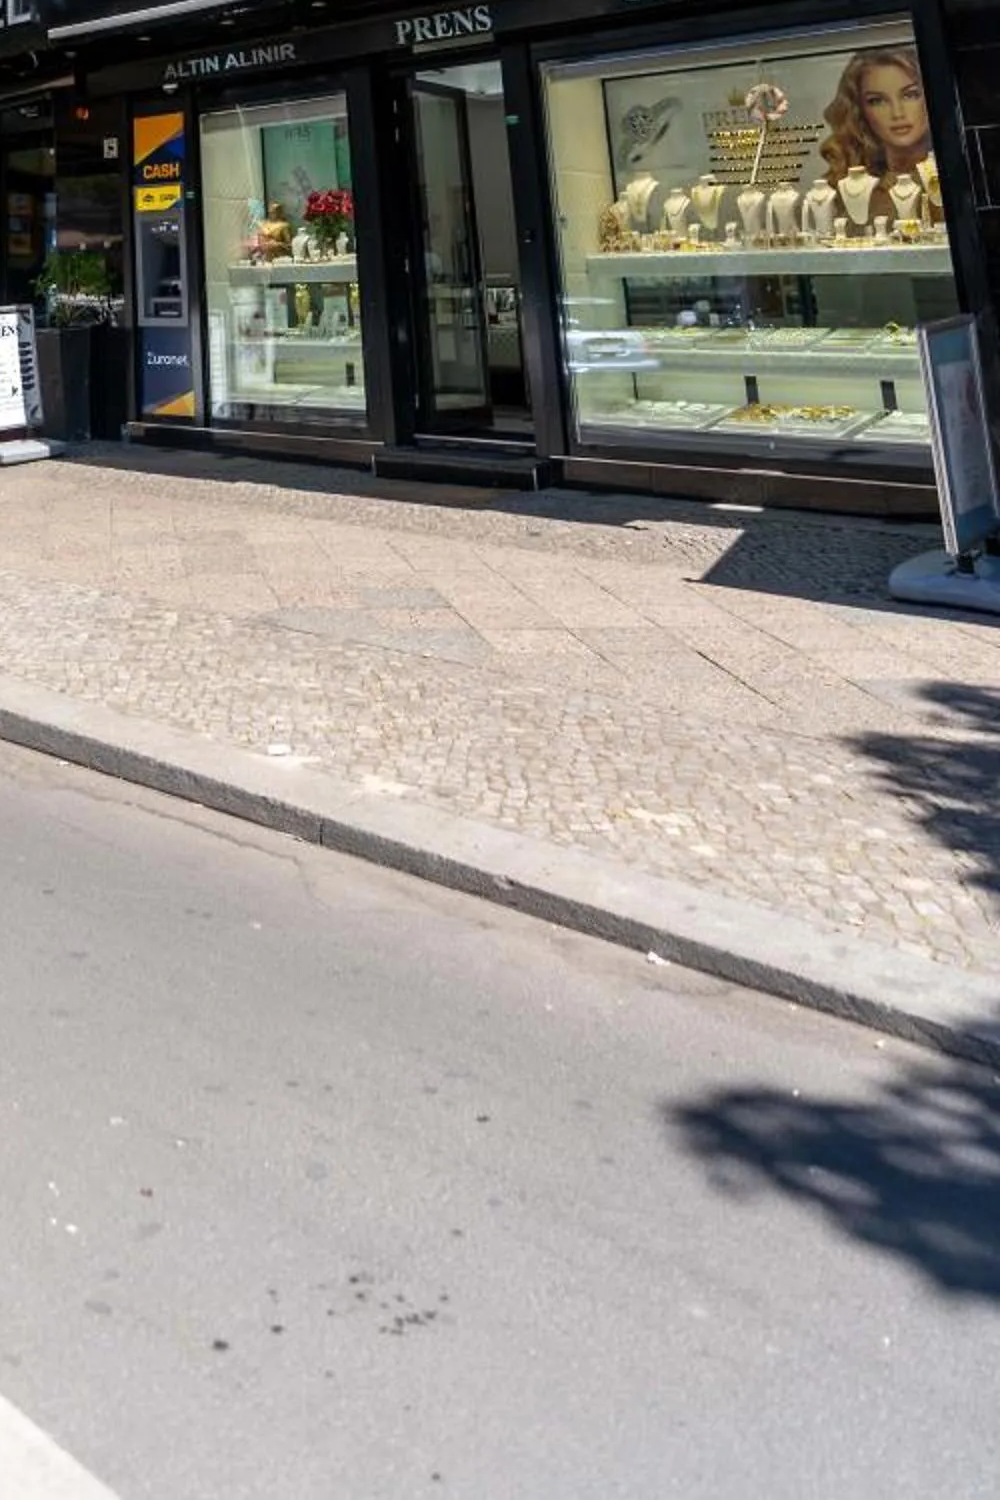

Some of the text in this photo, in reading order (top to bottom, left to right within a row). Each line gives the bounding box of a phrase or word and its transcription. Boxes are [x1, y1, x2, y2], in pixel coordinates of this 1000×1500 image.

[394, 5, 493, 45] PRENS
[165, 43, 296, 79] ALTIN ALINIR
[143, 163, 179, 179] CASH
